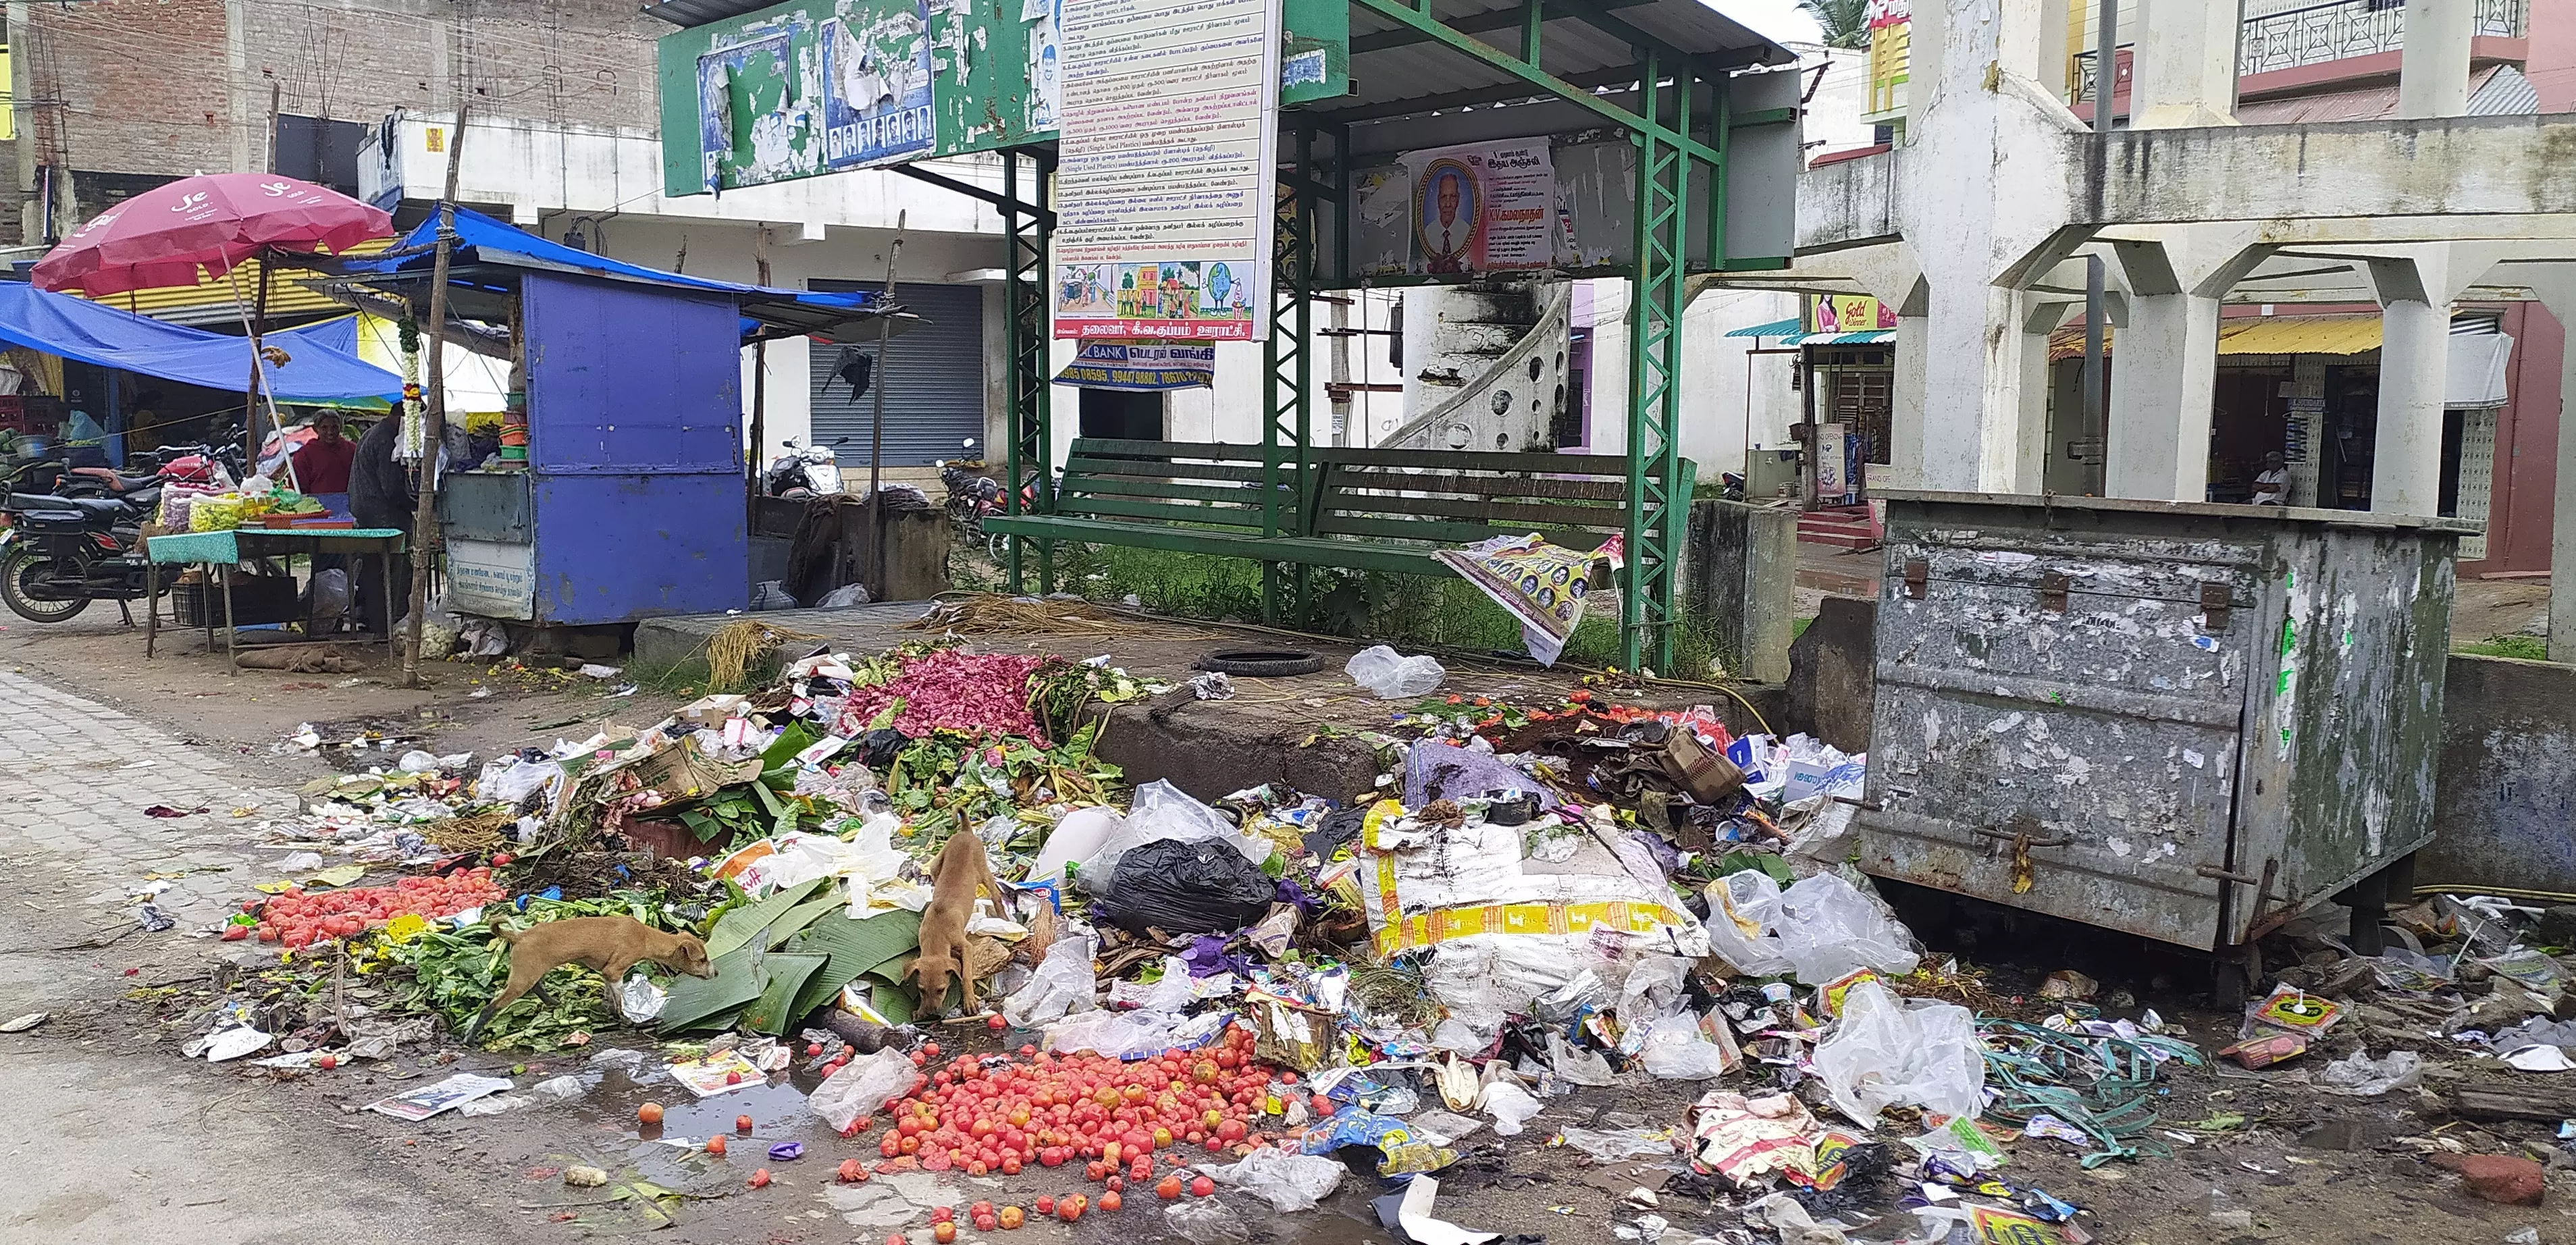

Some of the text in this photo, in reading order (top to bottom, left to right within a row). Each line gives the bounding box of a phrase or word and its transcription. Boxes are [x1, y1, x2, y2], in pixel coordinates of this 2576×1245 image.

[1120, 140, 1141, 149] Plastics)
[1097, 162, 1118, 170] Plastics)
[1488, 156, 1540, 169] இதய அஞ்சலி
[186, 203, 208, 213] GOLD
[1845, 300, 1868, 324] Gold
[1849, 318, 1866, 326] Winner
[1081, 321, 1245, 337] தலைவர், கீ.வ.குப்பம் ஊராட்சி.
[1093, 346, 1124, 359] BANK
[1129, 346, 1213, 361] பெடரல் வங்கி
[1112, 370, 1134, 383] 99447
